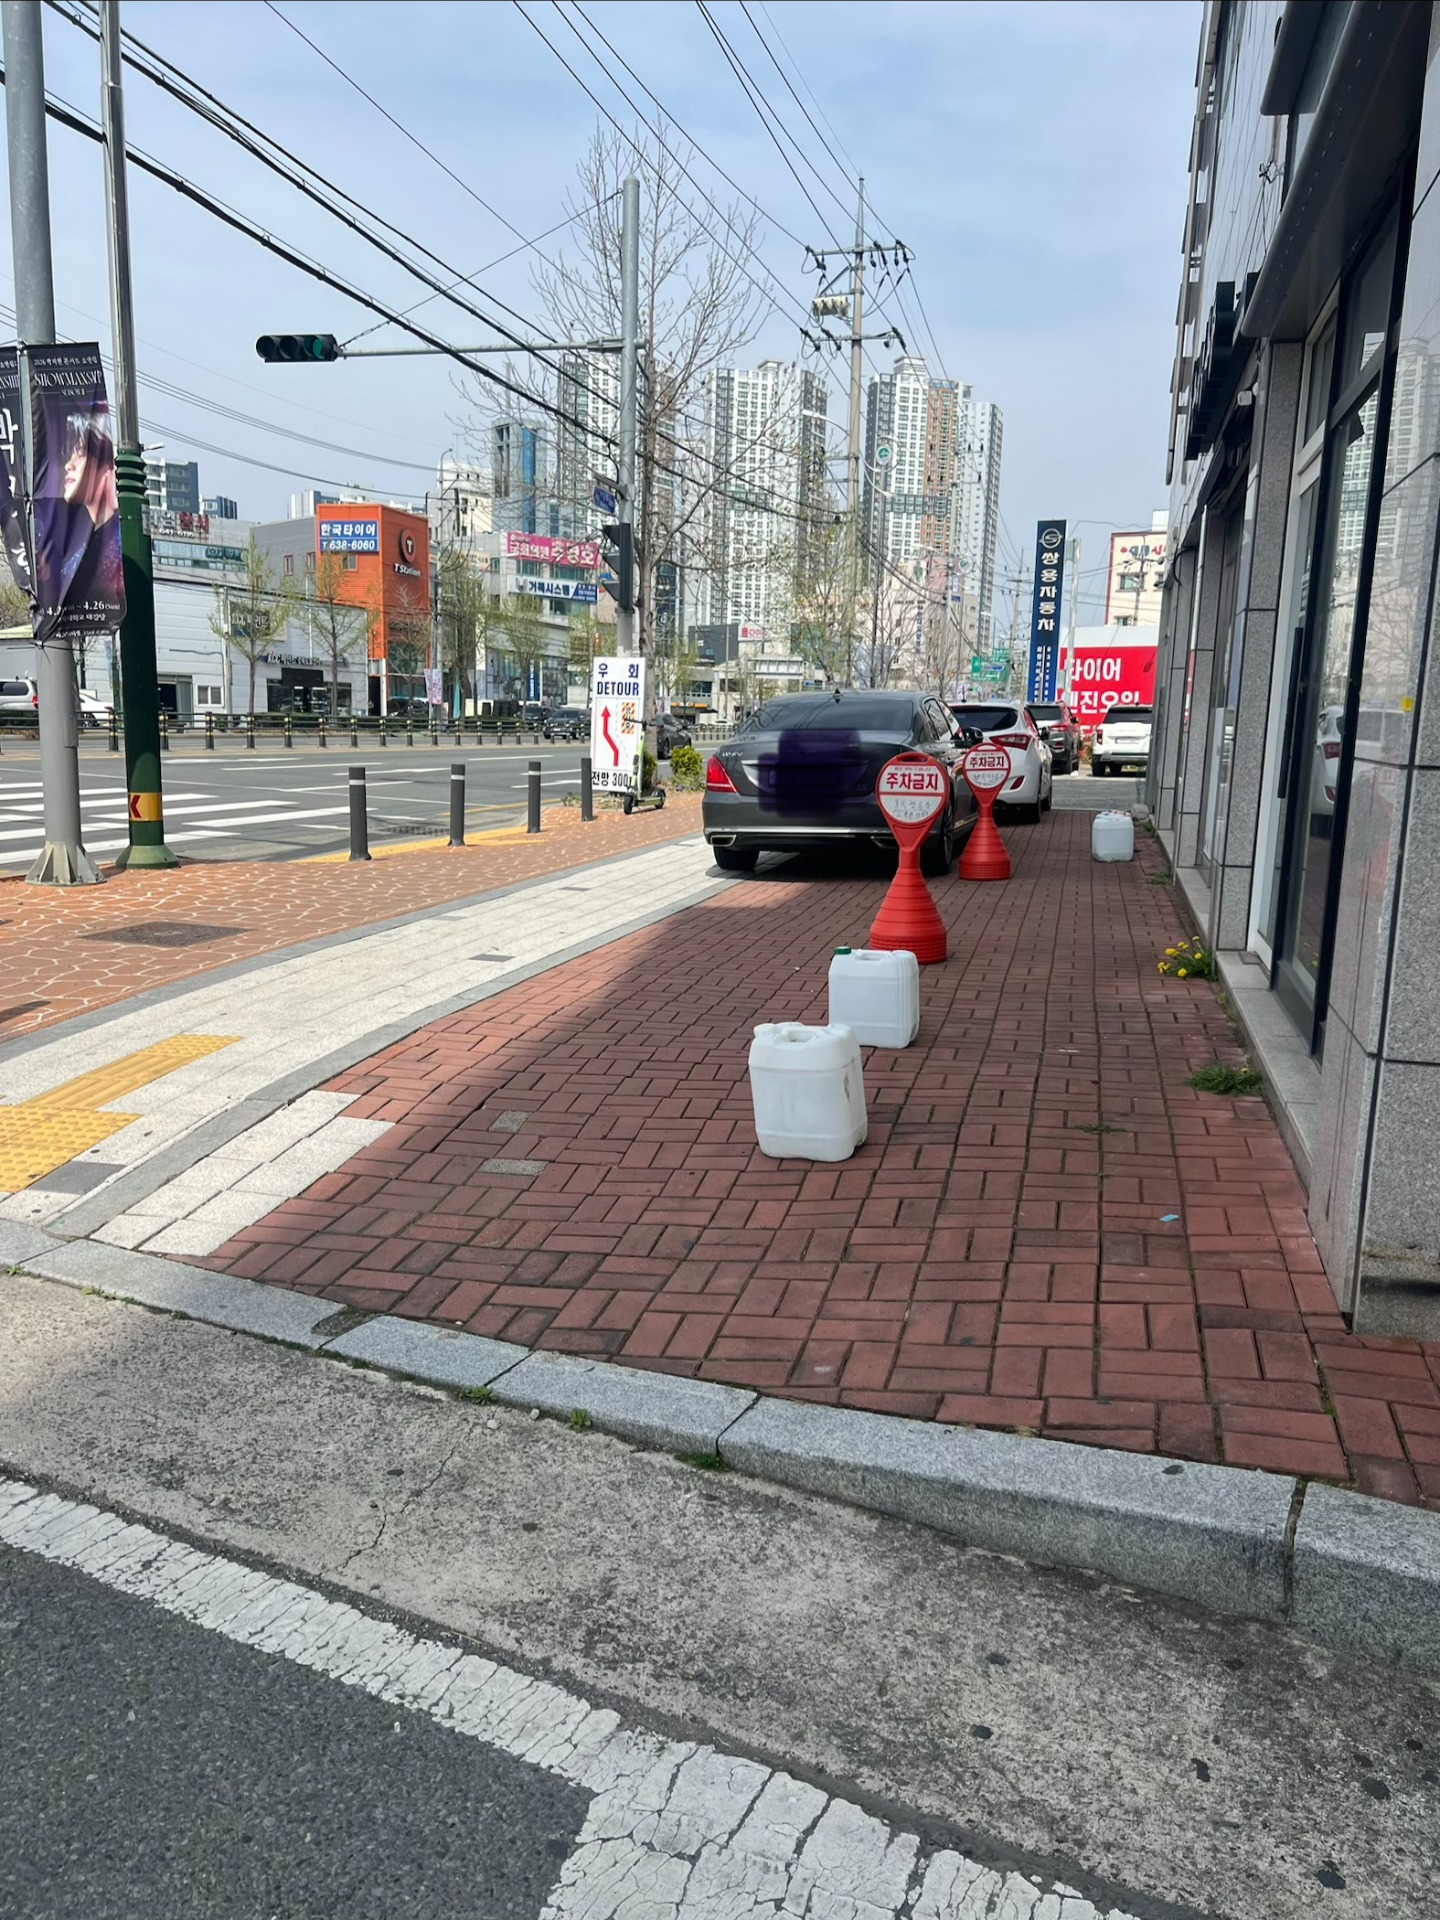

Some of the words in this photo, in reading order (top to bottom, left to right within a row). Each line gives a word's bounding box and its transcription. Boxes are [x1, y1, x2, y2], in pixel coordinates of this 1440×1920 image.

[321, 523, 376, 537] 한국타이어
[329, 539, 376, 552] 638-6060
[509, 541, 550, 560] 국회의원
[400, 564, 421, 577] Station
[1037, 551, 1060, 632] 쌍용자동차
[1064, 657, 1122, 682] 타이어
[597, 681, 640, 696] DETOUR
[970, 755, 1005, 768] 주차금지
[592, 771, 610, 787] 전방
[886, 772, 939, 791] 주차금지
